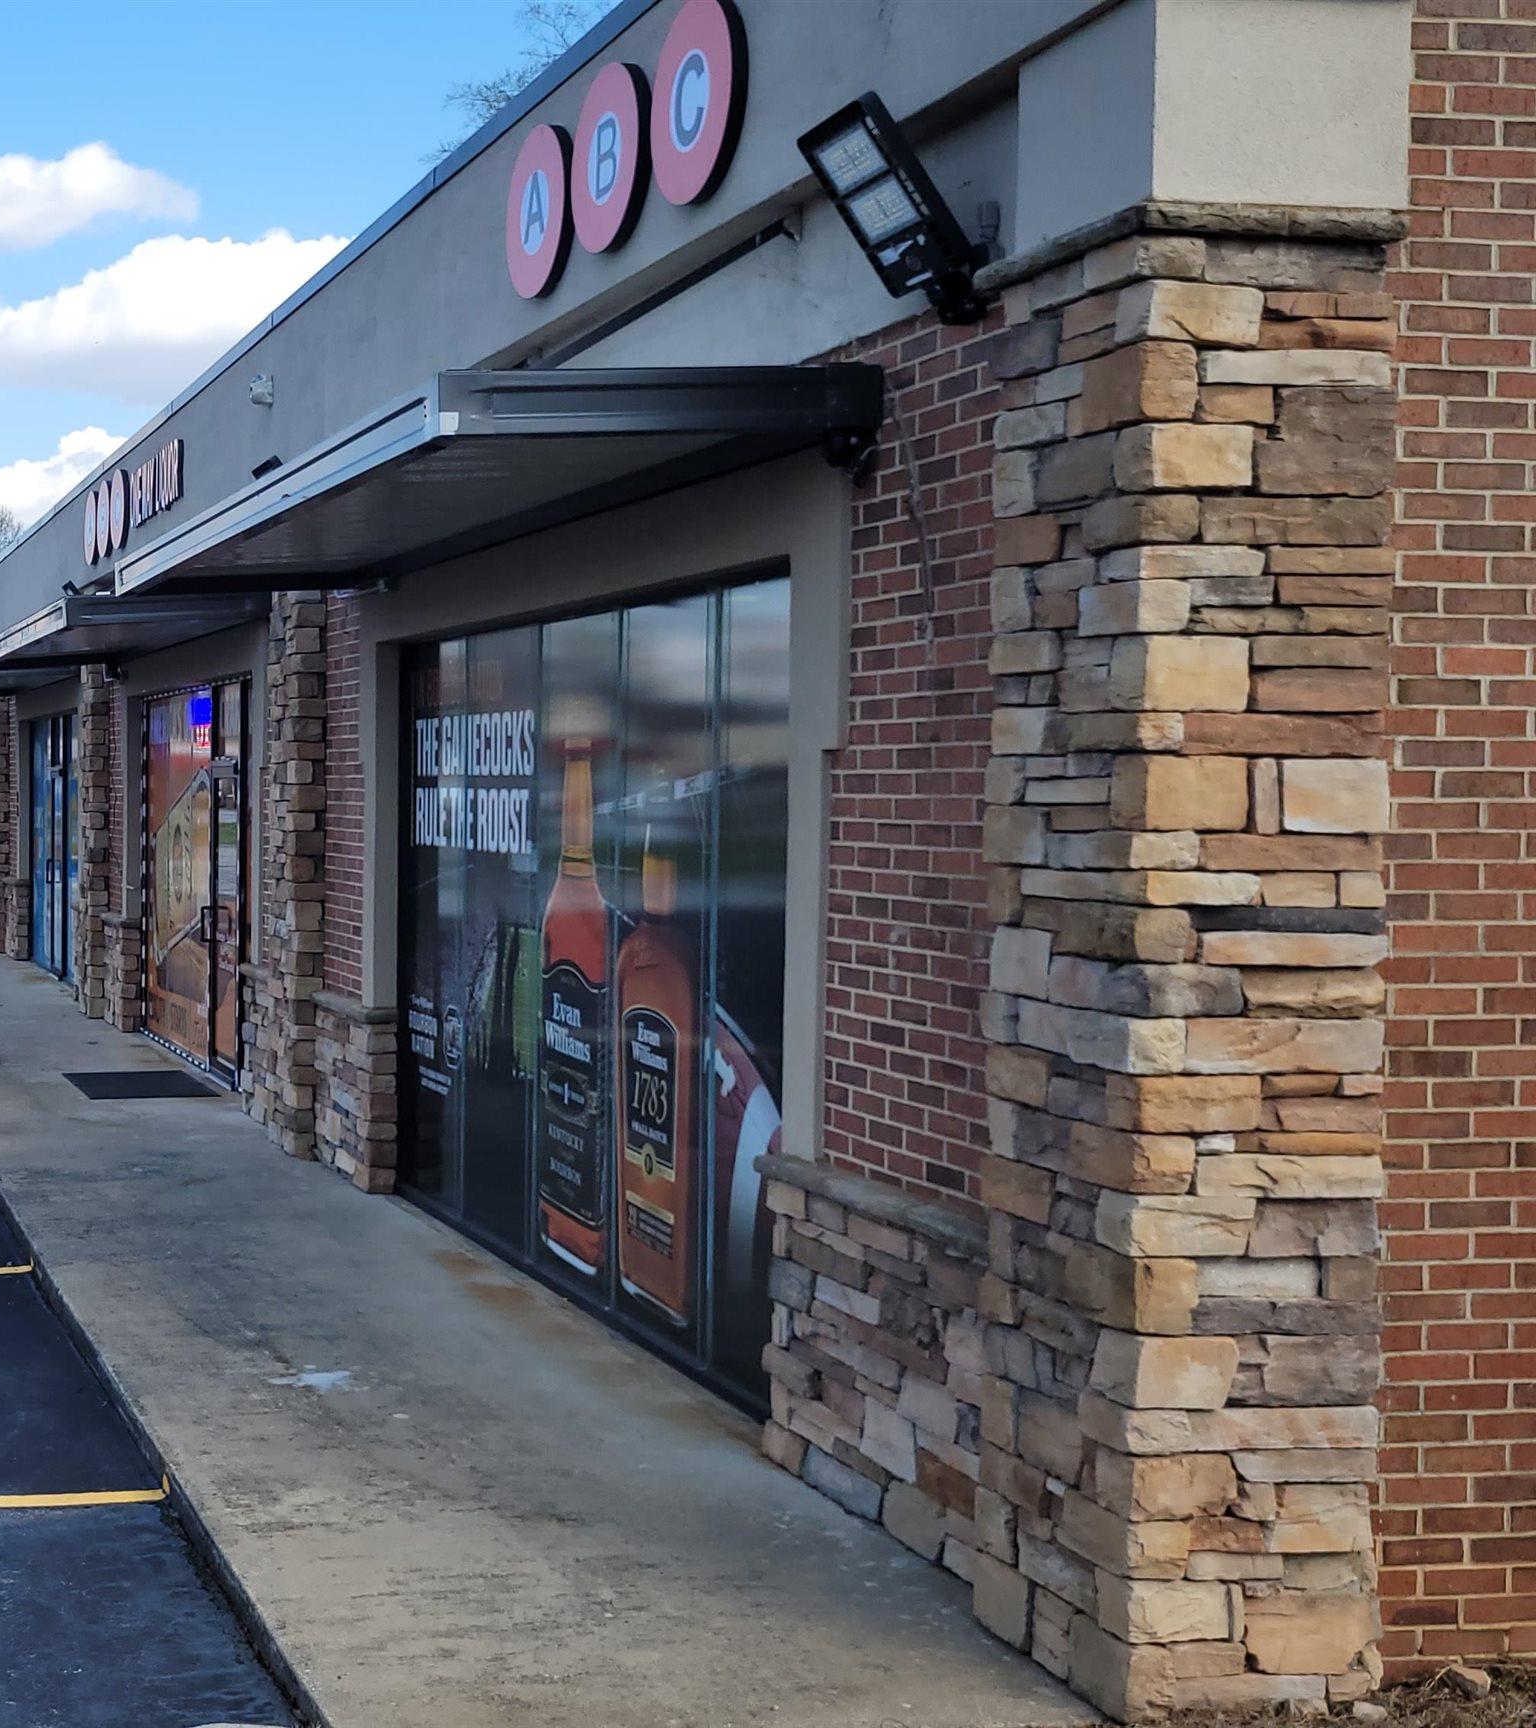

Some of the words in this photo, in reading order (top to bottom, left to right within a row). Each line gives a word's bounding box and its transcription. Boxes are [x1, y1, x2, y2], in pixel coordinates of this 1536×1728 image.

[416, 717, 439, 776] THE
[416, 787, 447, 847] RULE
[449, 787, 475, 850] THE
[552, 992, 581, 1029] Evan
[544, 1020, 592, 1064] Williams
[637, 1021, 660, 1047] Evan
[631, 1040, 668, 1073] Williams
[631, 1070, 668, 1124] 1783
[548, 1122, 584, 1152] KENTUCKY
